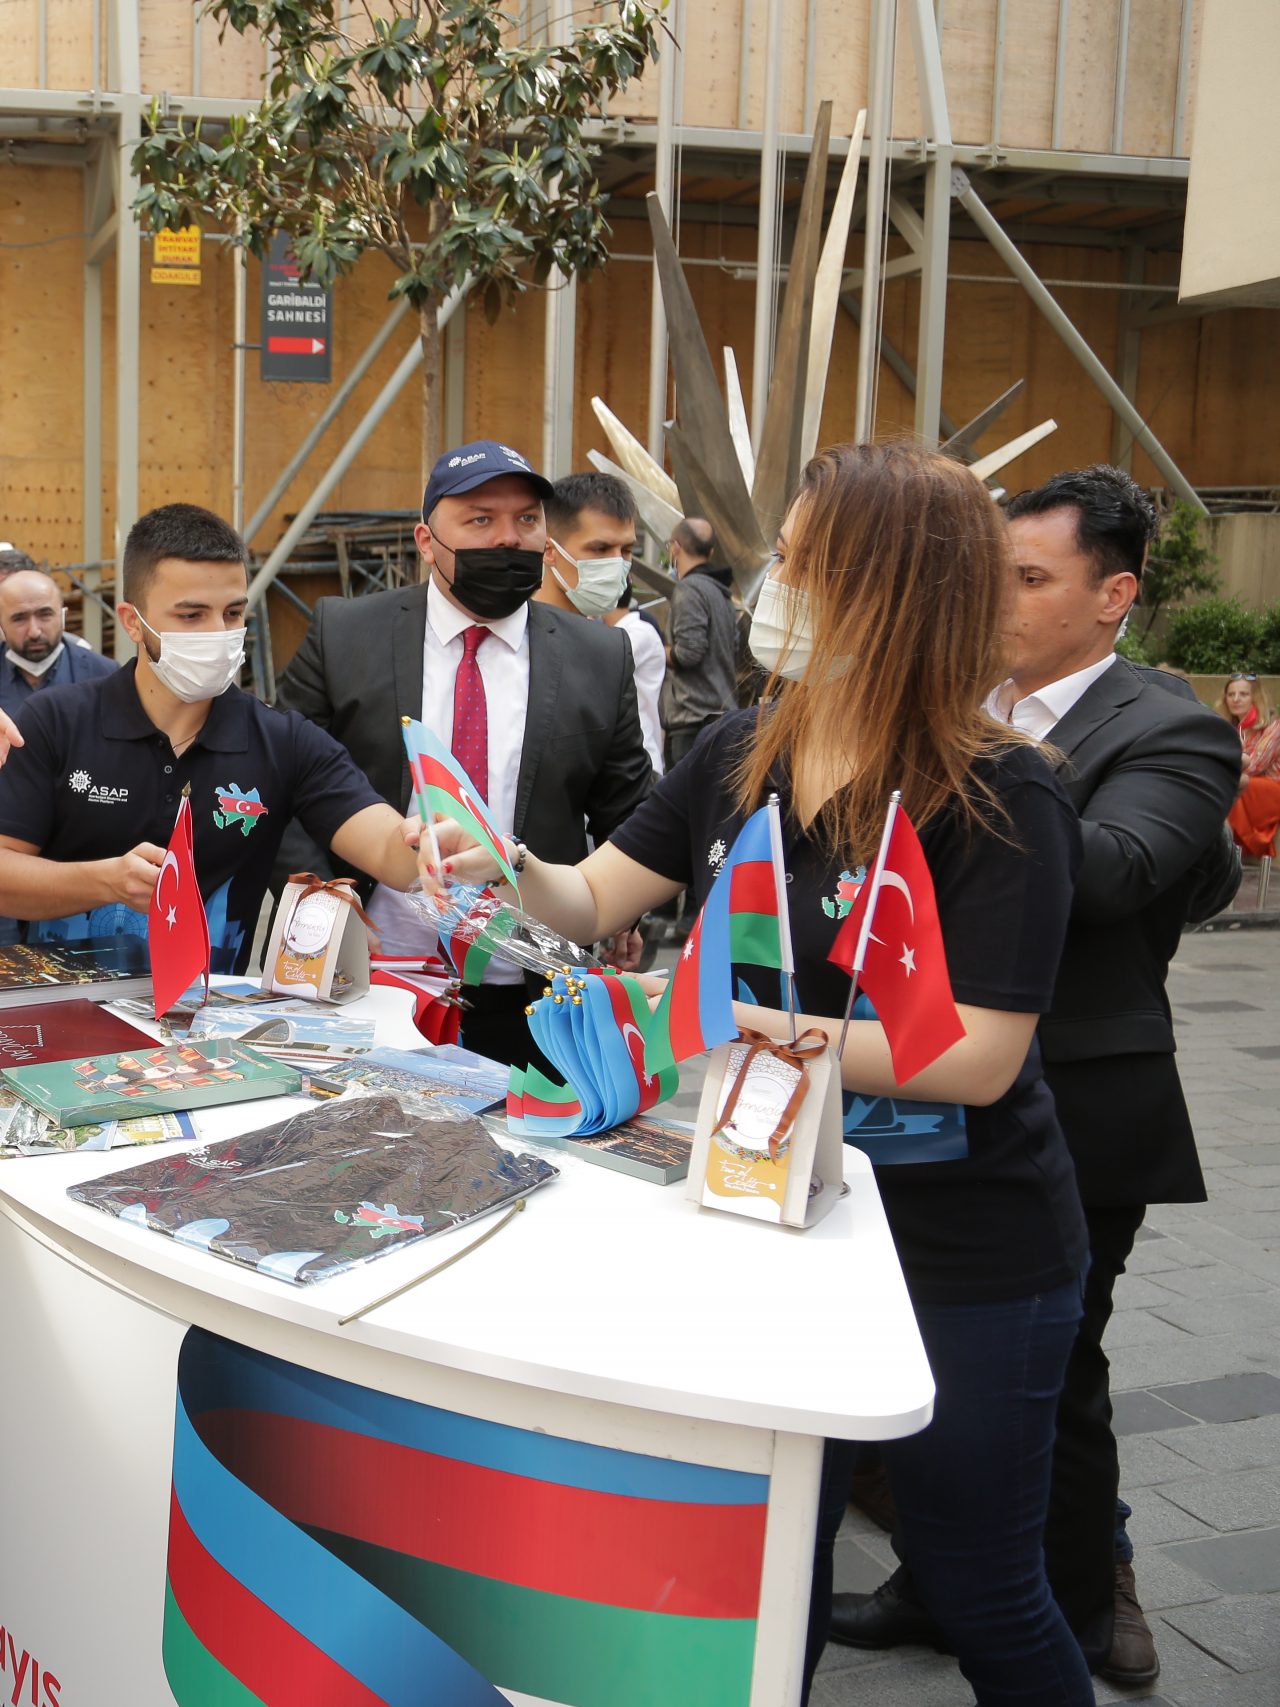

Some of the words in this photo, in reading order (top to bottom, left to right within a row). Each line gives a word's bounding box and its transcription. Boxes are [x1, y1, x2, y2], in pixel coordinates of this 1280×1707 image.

[267, 293, 326, 308] GARİBALDİ
[267, 309, 326, 323] SAHNESİ
[89, 785, 128, 798] ASAP
